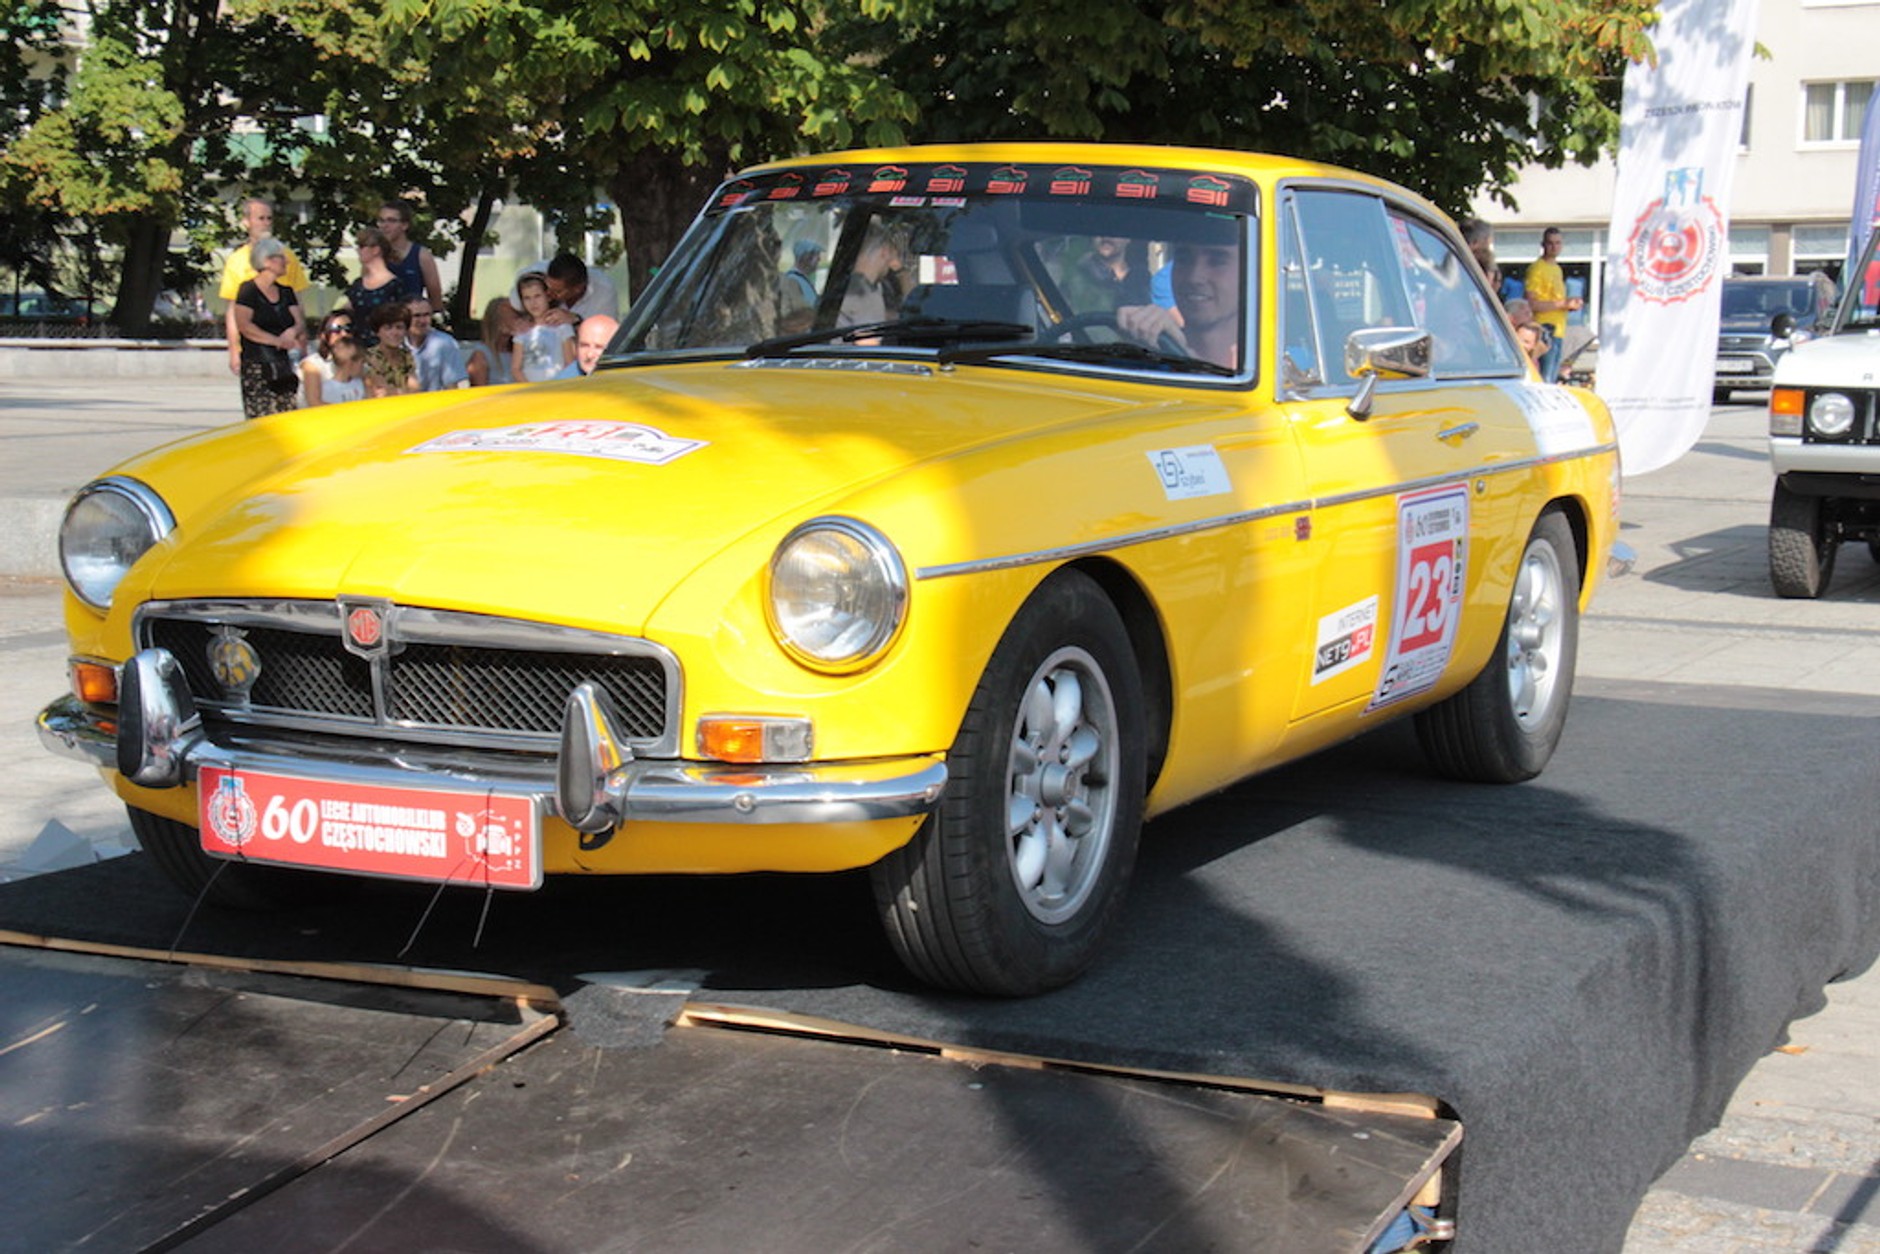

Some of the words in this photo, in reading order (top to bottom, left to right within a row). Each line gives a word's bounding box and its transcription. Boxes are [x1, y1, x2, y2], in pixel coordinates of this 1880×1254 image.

[1401, 554, 1451, 639] 23
[261, 795, 320, 844] 60
[320, 799, 352, 820] LECIE
[320, 820, 448, 859] CZĘSTOCHOWSKI
